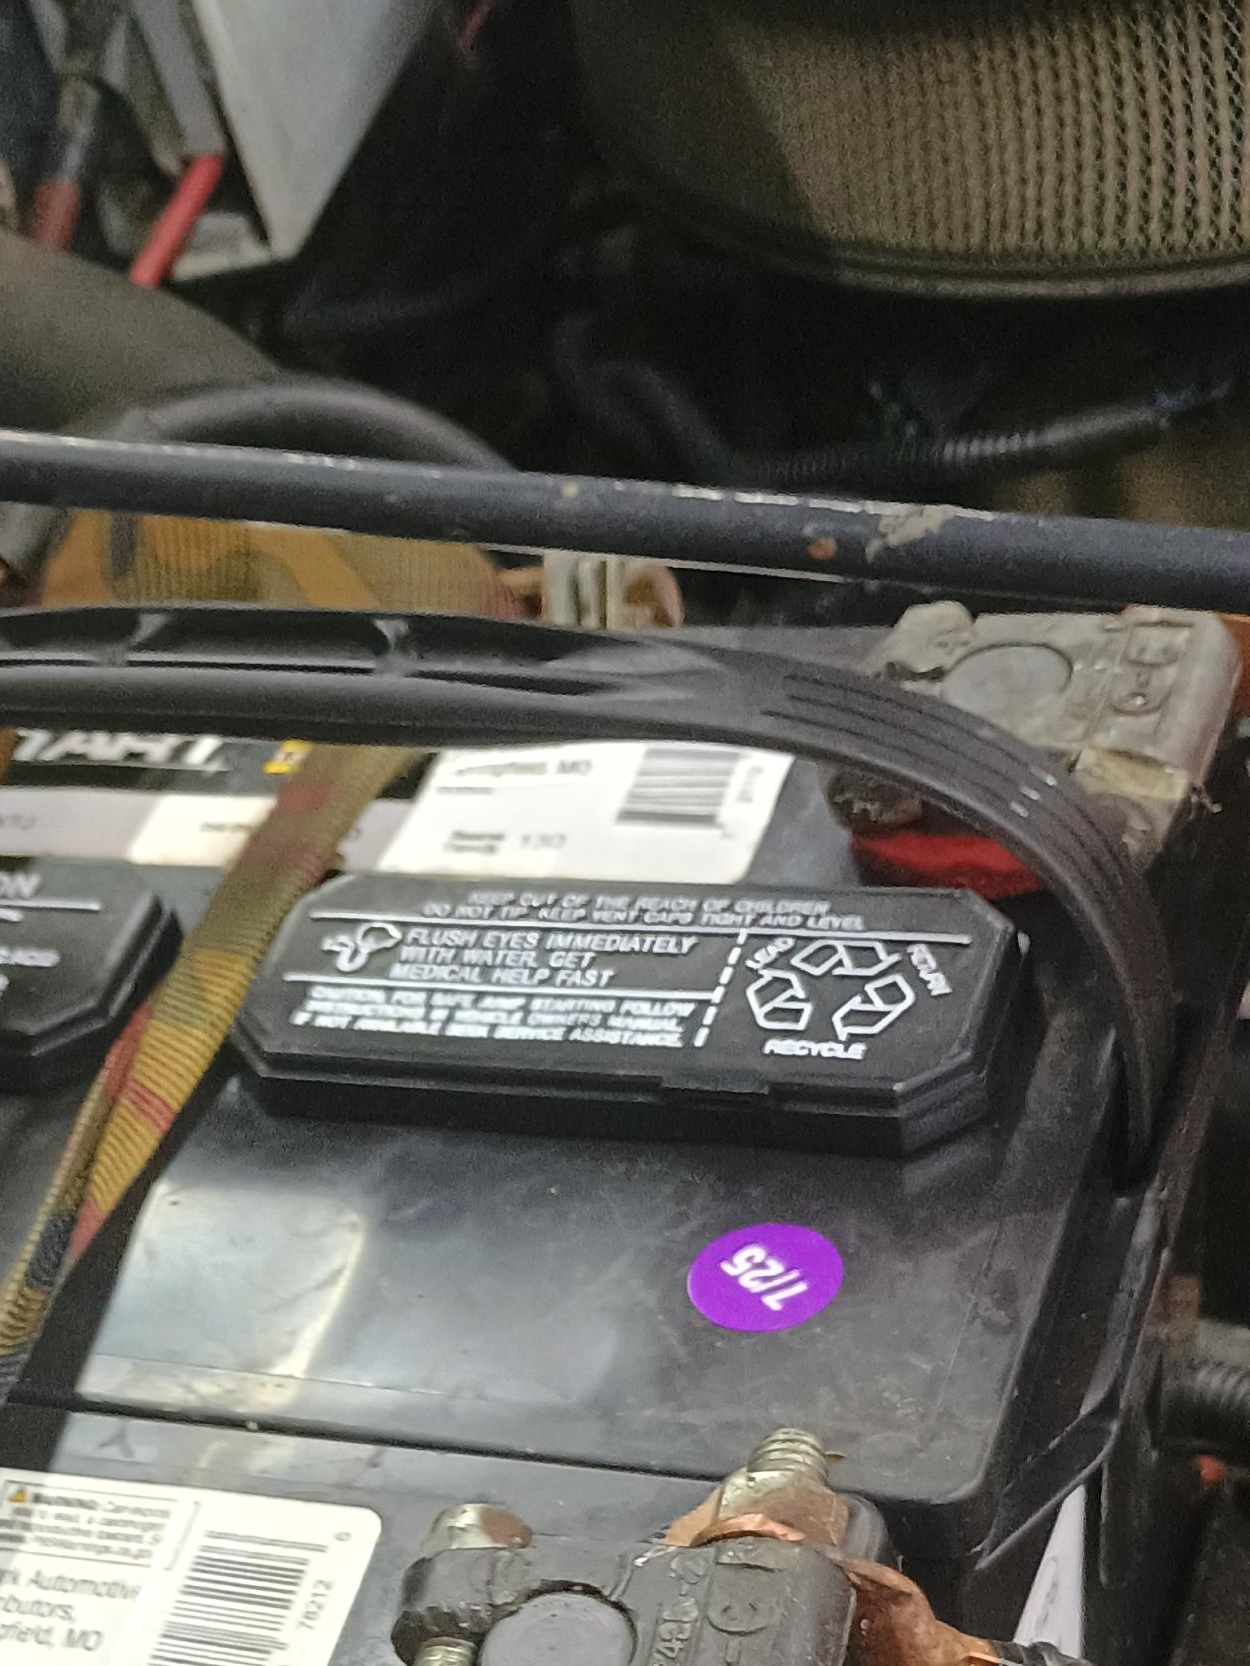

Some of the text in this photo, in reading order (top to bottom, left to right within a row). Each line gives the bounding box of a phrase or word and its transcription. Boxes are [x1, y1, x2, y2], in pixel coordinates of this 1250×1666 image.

[596, 894, 631, 910] THE
[636, 896, 698, 912] REACH
[701, 898, 731, 913] OF
[454, 904, 494, 919] NOT
[592, 909, 640, 924] VENT
[643, 911, 695, 925] CAPS
[759, 913, 802, 928] AND
[807, 914, 866, 931] LEVEL
[406, 926, 699, 954] FLUSH EYES IMMEDIATELY
[399, 947, 459, 966] WITH
[549, 951, 596, 969] GET
[388, 962, 616, 988] MEDICAL HELP FAST
[529, 997, 617, 1013] STARTING
[619, 1001, 699, 1018] FOLLOW
[762, 1038, 869, 1060] RECYCLE
[718, 1243, 810, 1312] 7/25
[63, 1628, 106, 1652] MO
